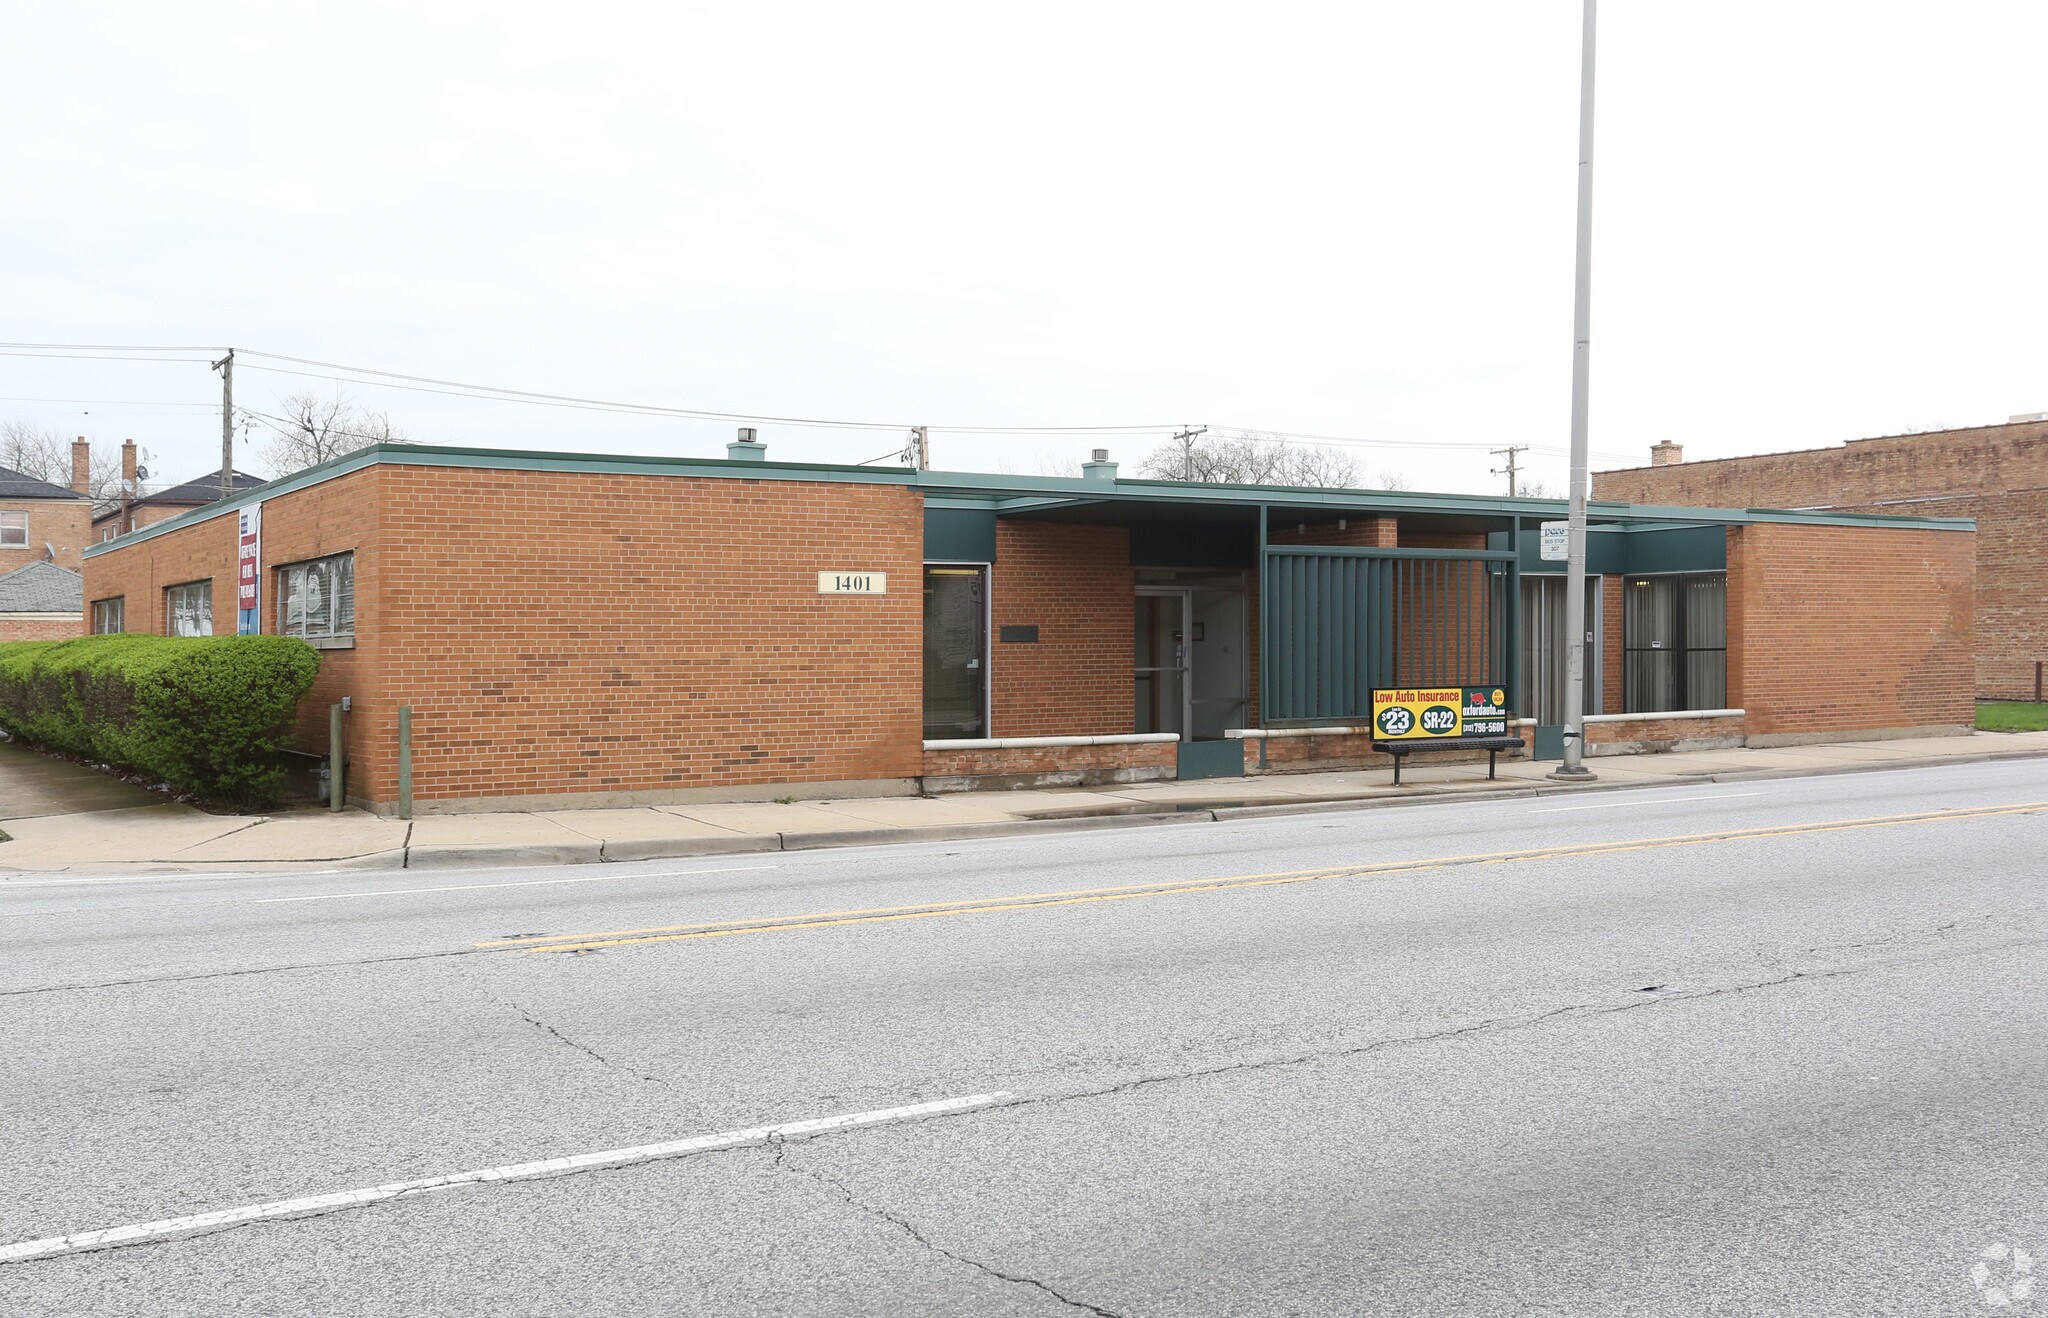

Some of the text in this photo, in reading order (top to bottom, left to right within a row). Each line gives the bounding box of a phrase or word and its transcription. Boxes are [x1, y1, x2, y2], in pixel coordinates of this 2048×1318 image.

[835, 575, 871, 591] 1401
[1375, 690, 1459, 703] Low Auto Insurance
[1463, 704, 1505, 716] oxfordauto.com
[1381, 711, 1409, 730] $23
[1474, 722, 1505, 733] 796-5600
